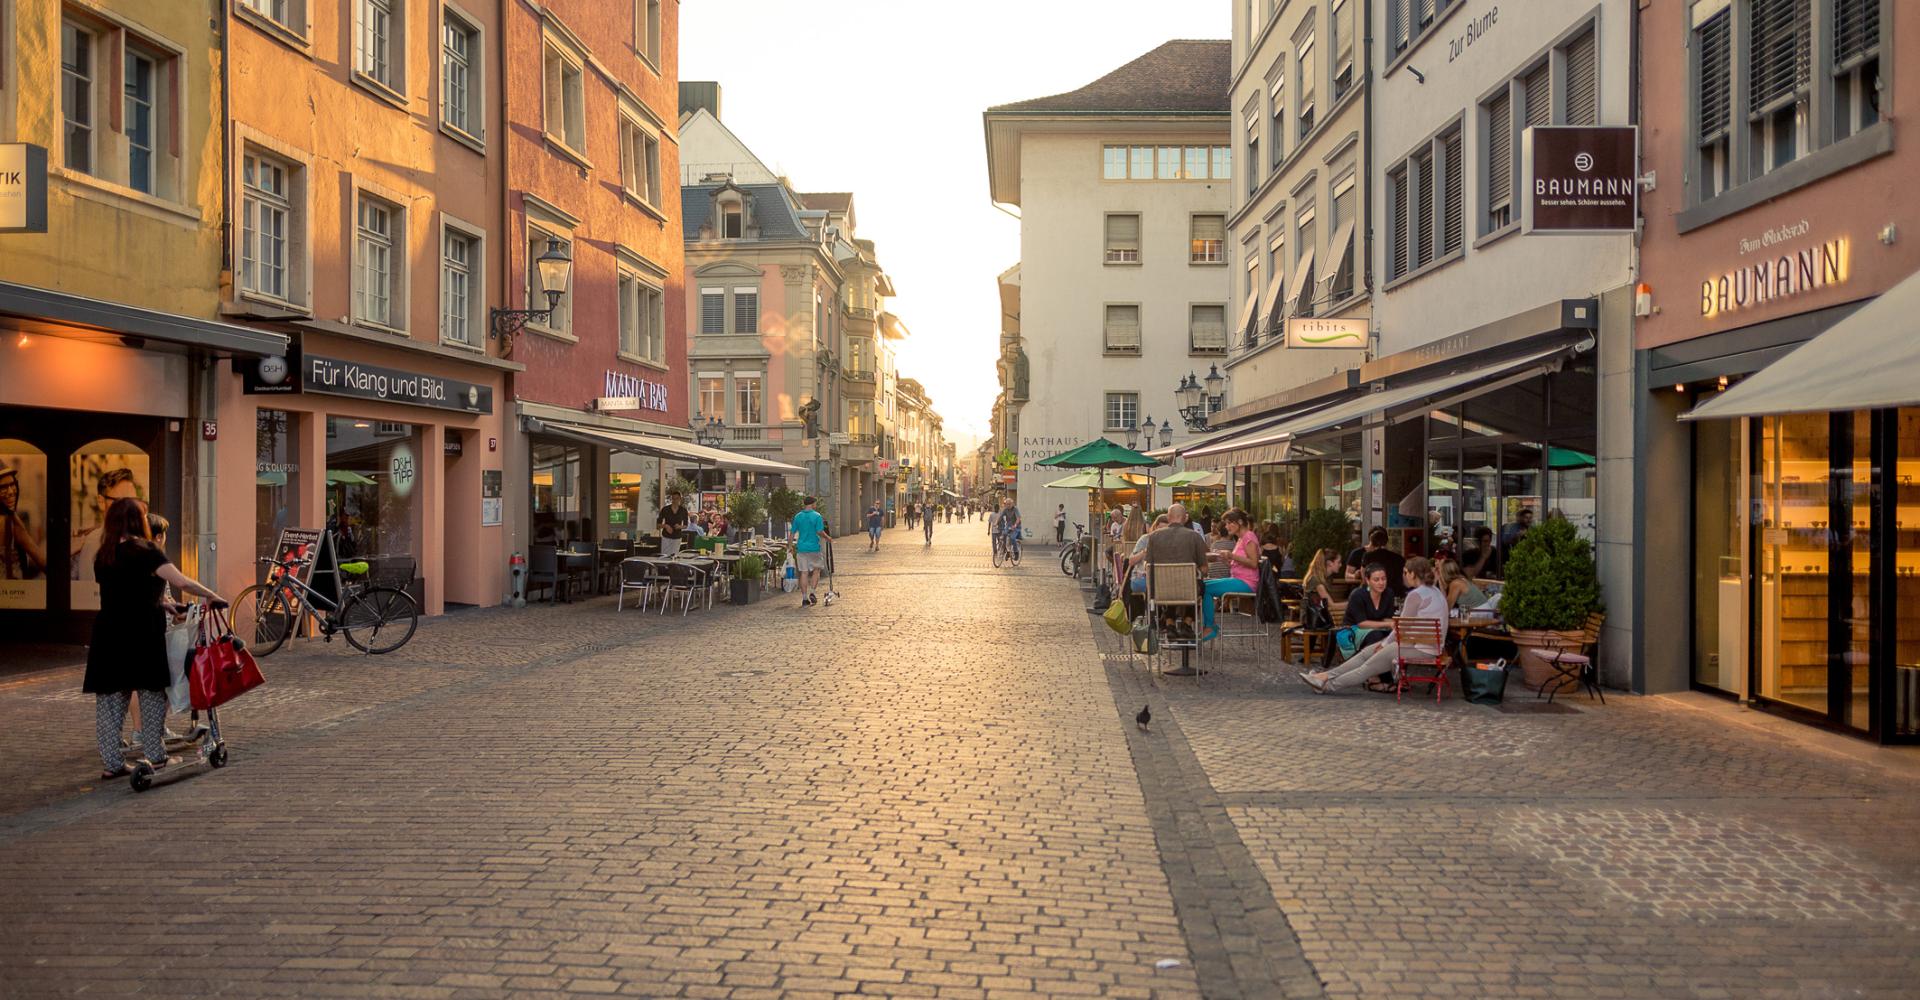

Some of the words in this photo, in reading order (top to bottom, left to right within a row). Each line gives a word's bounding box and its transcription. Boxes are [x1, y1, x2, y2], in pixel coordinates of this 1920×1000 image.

[1449, 35, 1464, 64] Zur
[1467, 6, 1498, 47] Blume
[1536, 179, 1632, 195] BAUMANN
[1578, 198, 1599, 206] Schöner
[1701, 239, 1846, 316] BAUMANN
[1303, 321, 1347, 332] tibits
[312, 360, 340, 385] Für
[345, 365, 387, 398] Klang
[391, 377, 418, 397] und
[421, 378, 446, 401] Bild.
[650, 381, 668, 413] BAR
[204, 423, 217, 436] 35
[489, 439, 496, 448] 37
[1023, 437, 1085, 446] RATHAUS-
[393, 456, 412, 471] D&H
[393, 470, 413, 485] TIPP
